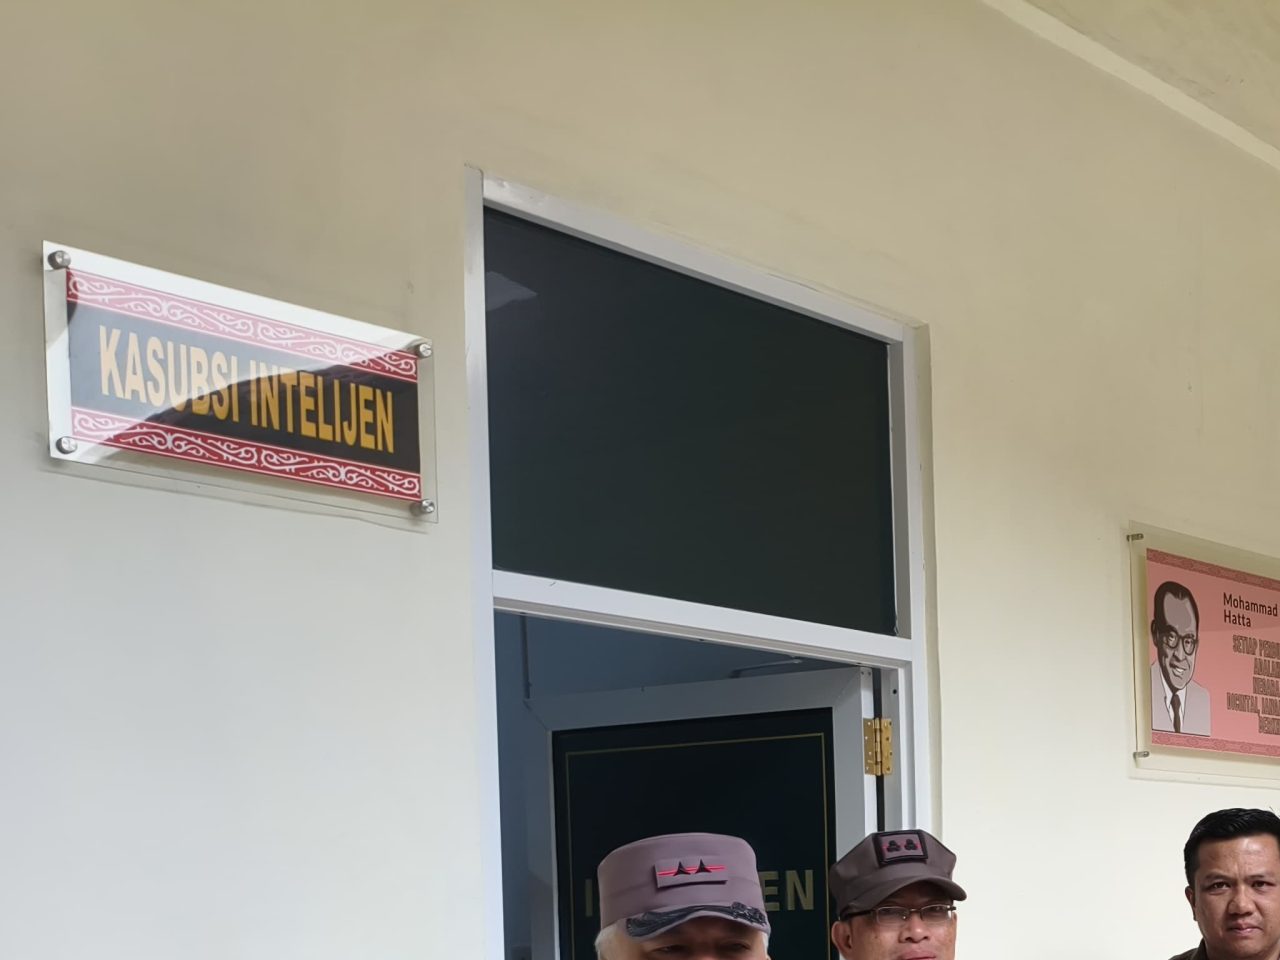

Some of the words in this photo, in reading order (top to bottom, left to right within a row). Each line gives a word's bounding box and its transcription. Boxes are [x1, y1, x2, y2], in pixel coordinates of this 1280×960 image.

[99, 324, 239, 424] KASUBSI
[249, 360, 395, 454] INTELIJEN
[1222, 592, 1279, 617] Mohammad
[1223, 609, 1252, 628] Hatta
